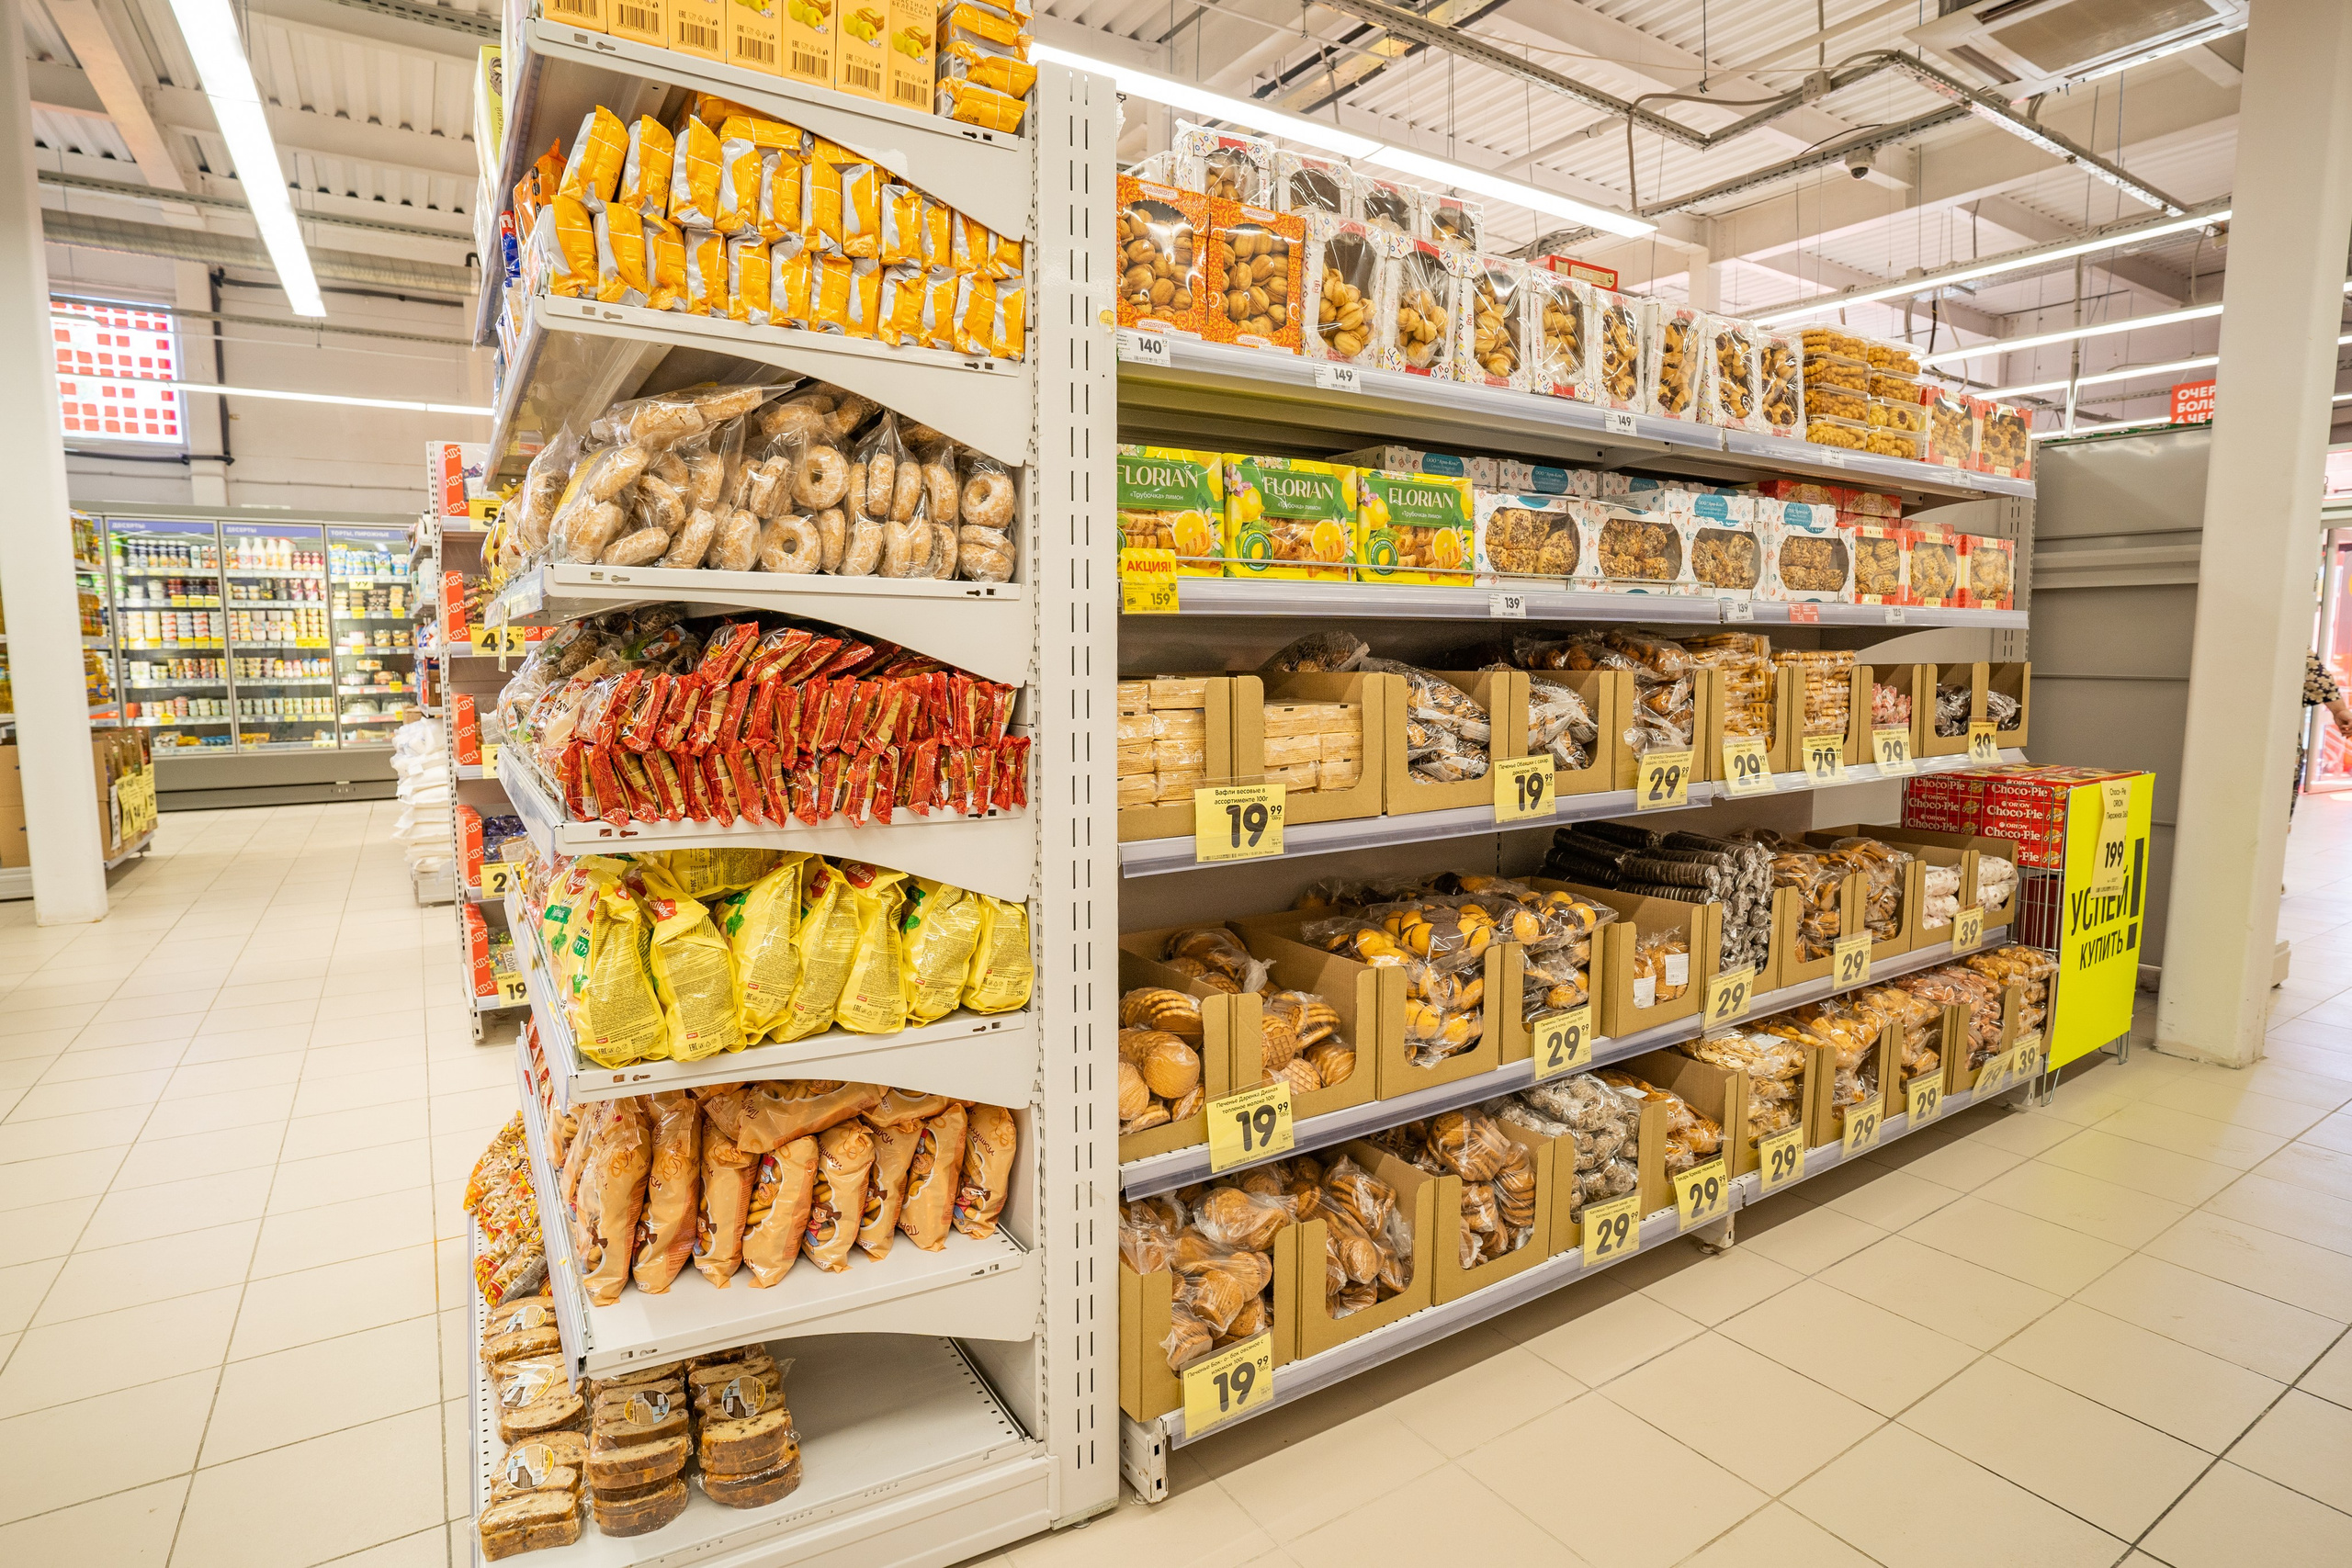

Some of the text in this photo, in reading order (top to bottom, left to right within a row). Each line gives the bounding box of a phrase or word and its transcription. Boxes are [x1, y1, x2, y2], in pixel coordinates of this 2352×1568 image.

[1137, 337, 1161, 355] 140
[1334, 368, 1353, 382] 149
[1617, 415, 1631, 427] 149
[1117, 464, 1198, 489] FLORIAN
[1263, 477, 1334, 500] FLORIAN
[1130, 491, 1165, 501] «Трубочка»
[1277, 502, 1304, 511] «Трубочка»
[1388, 487, 1453, 509] FLORIAN
[1401, 511, 1427, 519] «Трубочка»
[1126, 560, 1172, 573] АКЦИЯ!
[1151, 593, 1170, 605] 159
[1505, 597, 1520, 609] 139
[1737, 604, 1748, 613] 139
[1883, 740, 1903, 767] 29
[1975, 733, 1991, 758] 39
[1734, 753, 1760, 785] 29
[1813, 747, 1836, 778] 29
[1515, 773, 1553, 811] 19 99
[1649, 765, 1680, 801] 29
[1226, 803, 1282, 848] 19 99
[2105, 840, 2124, 868] 199
[2071, 865, 2130, 936] УСПЕЙ
[1960, 919, 1978, 946] 39
[2080, 930, 2123, 970] КУПИТЬ
[1842, 950, 1863, 982] 29
[506, 982, 526, 999] 19
[1715, 983, 1745, 1018] 29
[1547, 1024, 1589, 1067] 29 99
[2018, 1047, 2035, 1075] 39
[1979, 1066, 2003, 1092] 29
[1216, 1093, 1260, 1108] Печенье Даренка
[1222, 1106, 1246, 1114] топленое
[1247, 1099, 1265, 1107] молоко
[1917, 1088, 1936, 1120] 29
[1236, 1102, 1288, 1152] 19 99
[1852, 1114, 1875, 1148] 29
[1702, 1164, 1716, 1173] Нежный
[1771, 1145, 1795, 1182] 29
[1690, 1175, 1726, 1218] 29 99
[1597, 1211, 1638, 1255] 29 99
[1187, 1365, 1210, 1378] Печенье
[1240, 1343, 1260, 1353] овсяное
[1211, 1363, 1232, 1374] изюмом
[1213, 1355, 1268, 1412] 19 99
